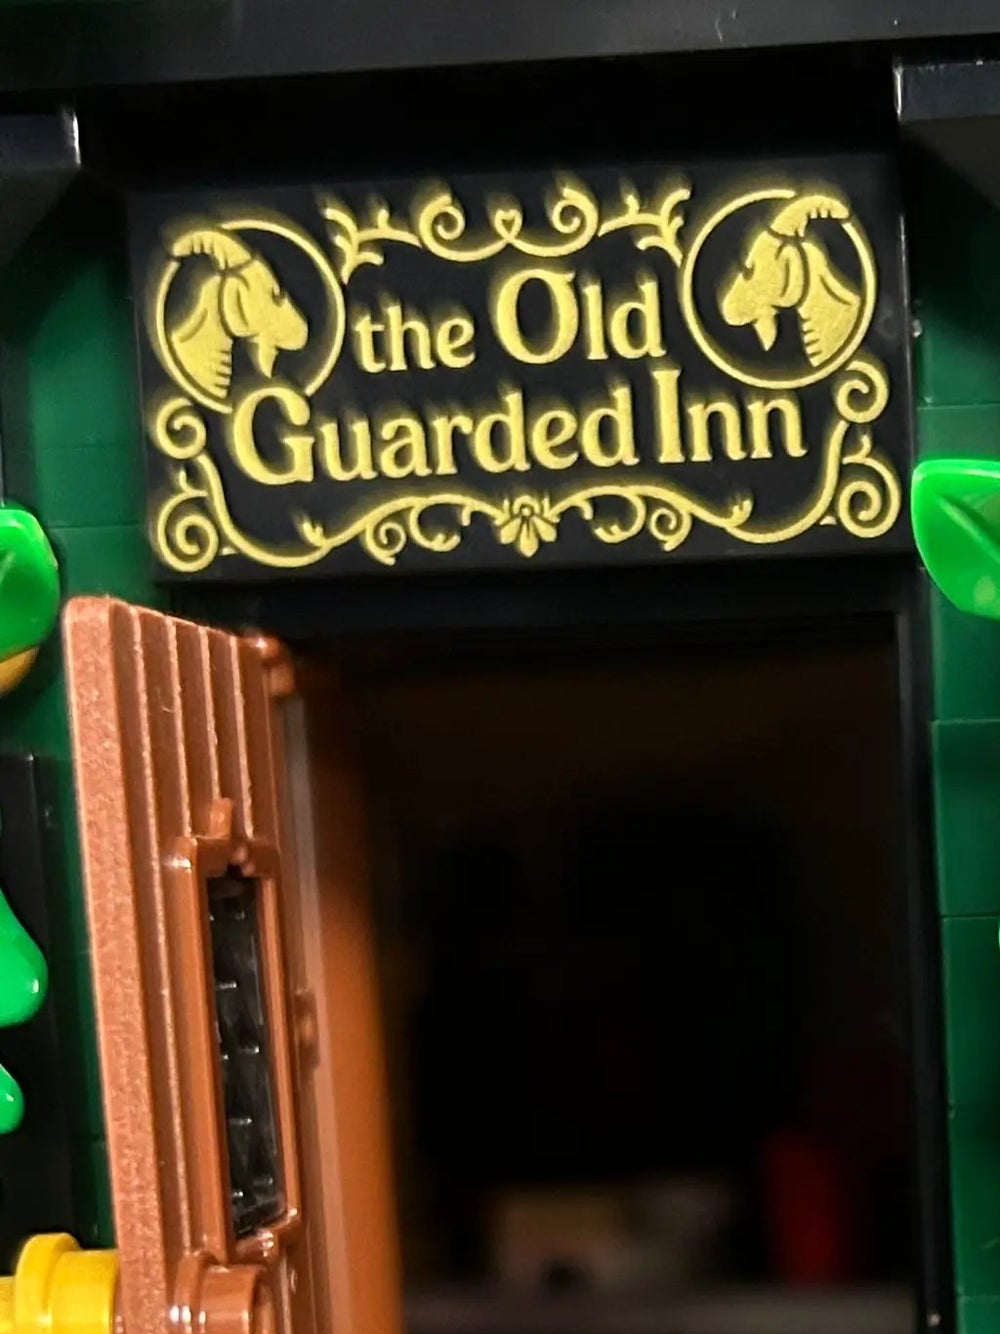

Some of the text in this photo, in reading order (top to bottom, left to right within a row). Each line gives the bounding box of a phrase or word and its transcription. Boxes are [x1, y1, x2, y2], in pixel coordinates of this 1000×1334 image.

[353, 267, 665, 372] the Old
[233, 366, 805, 485] Guarded Inn
